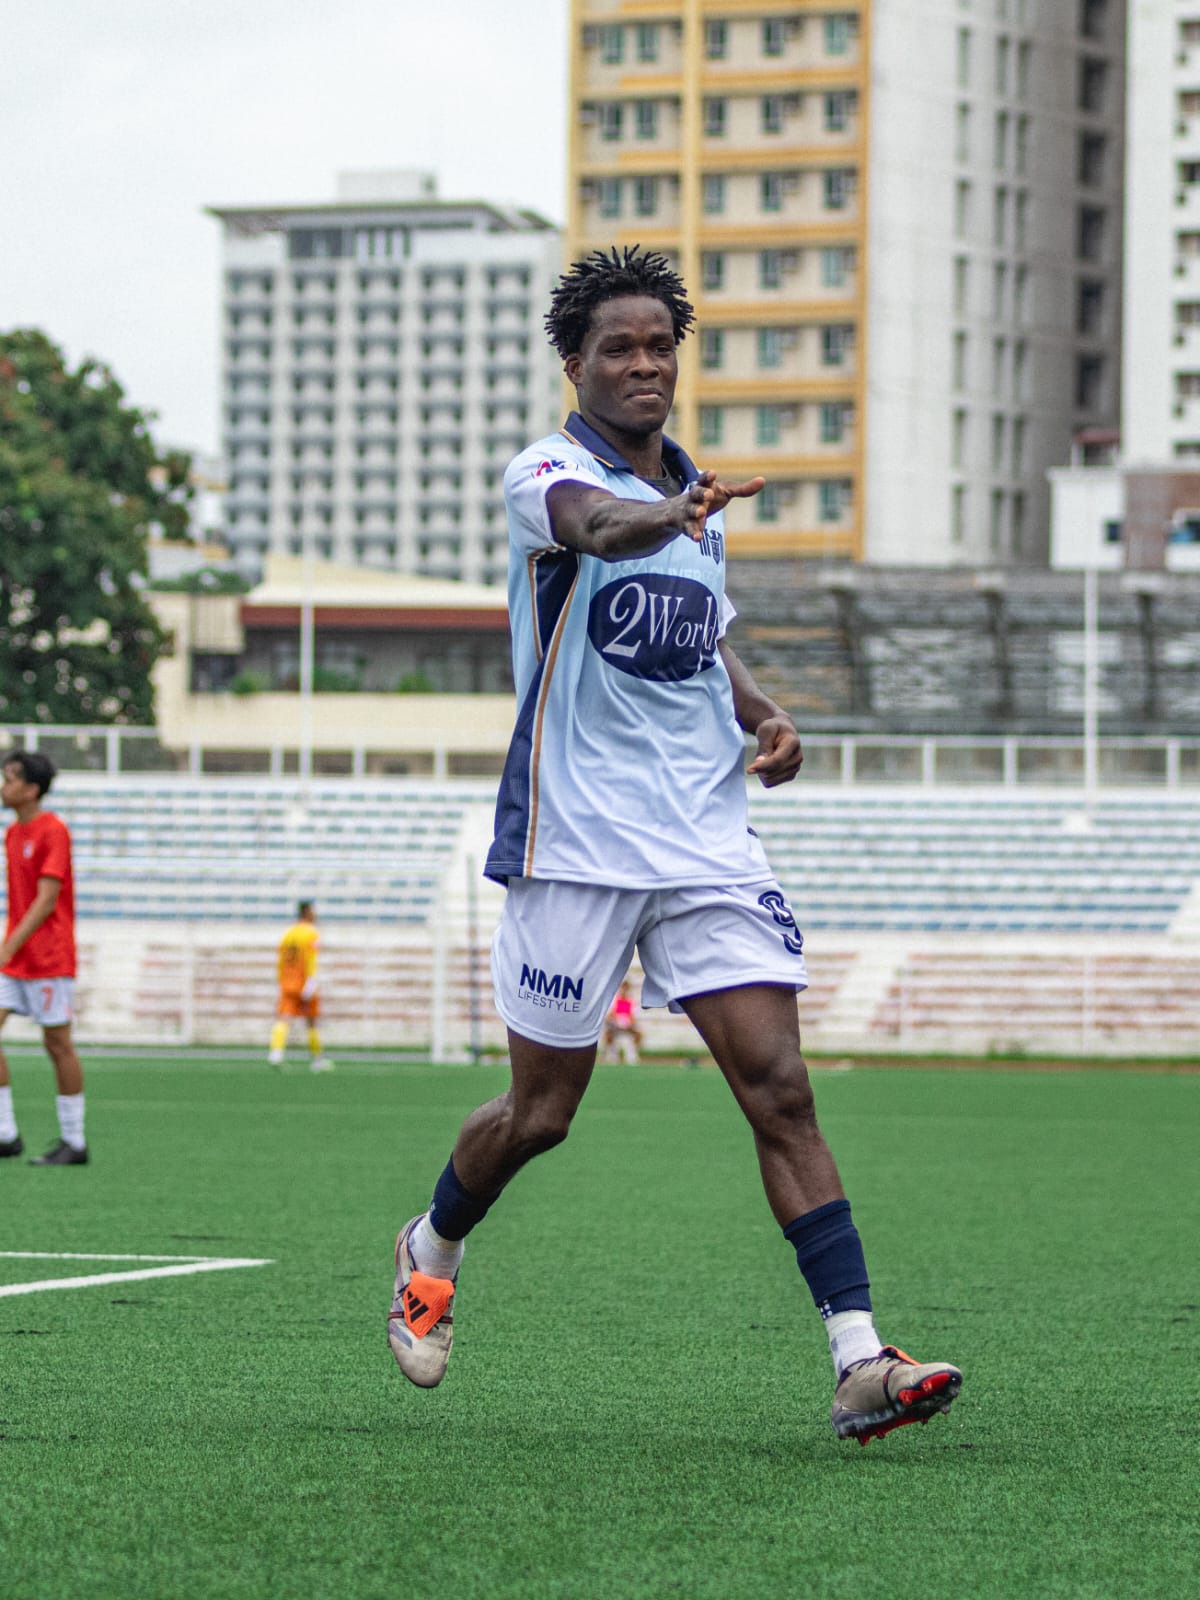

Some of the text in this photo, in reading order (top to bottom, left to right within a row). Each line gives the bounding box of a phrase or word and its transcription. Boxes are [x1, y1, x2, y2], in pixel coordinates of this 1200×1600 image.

[519, 963, 584, 1001] NMN
[40, 986, 55, 1014] 7
[518, 987, 582, 1013] LIFESTYLE
